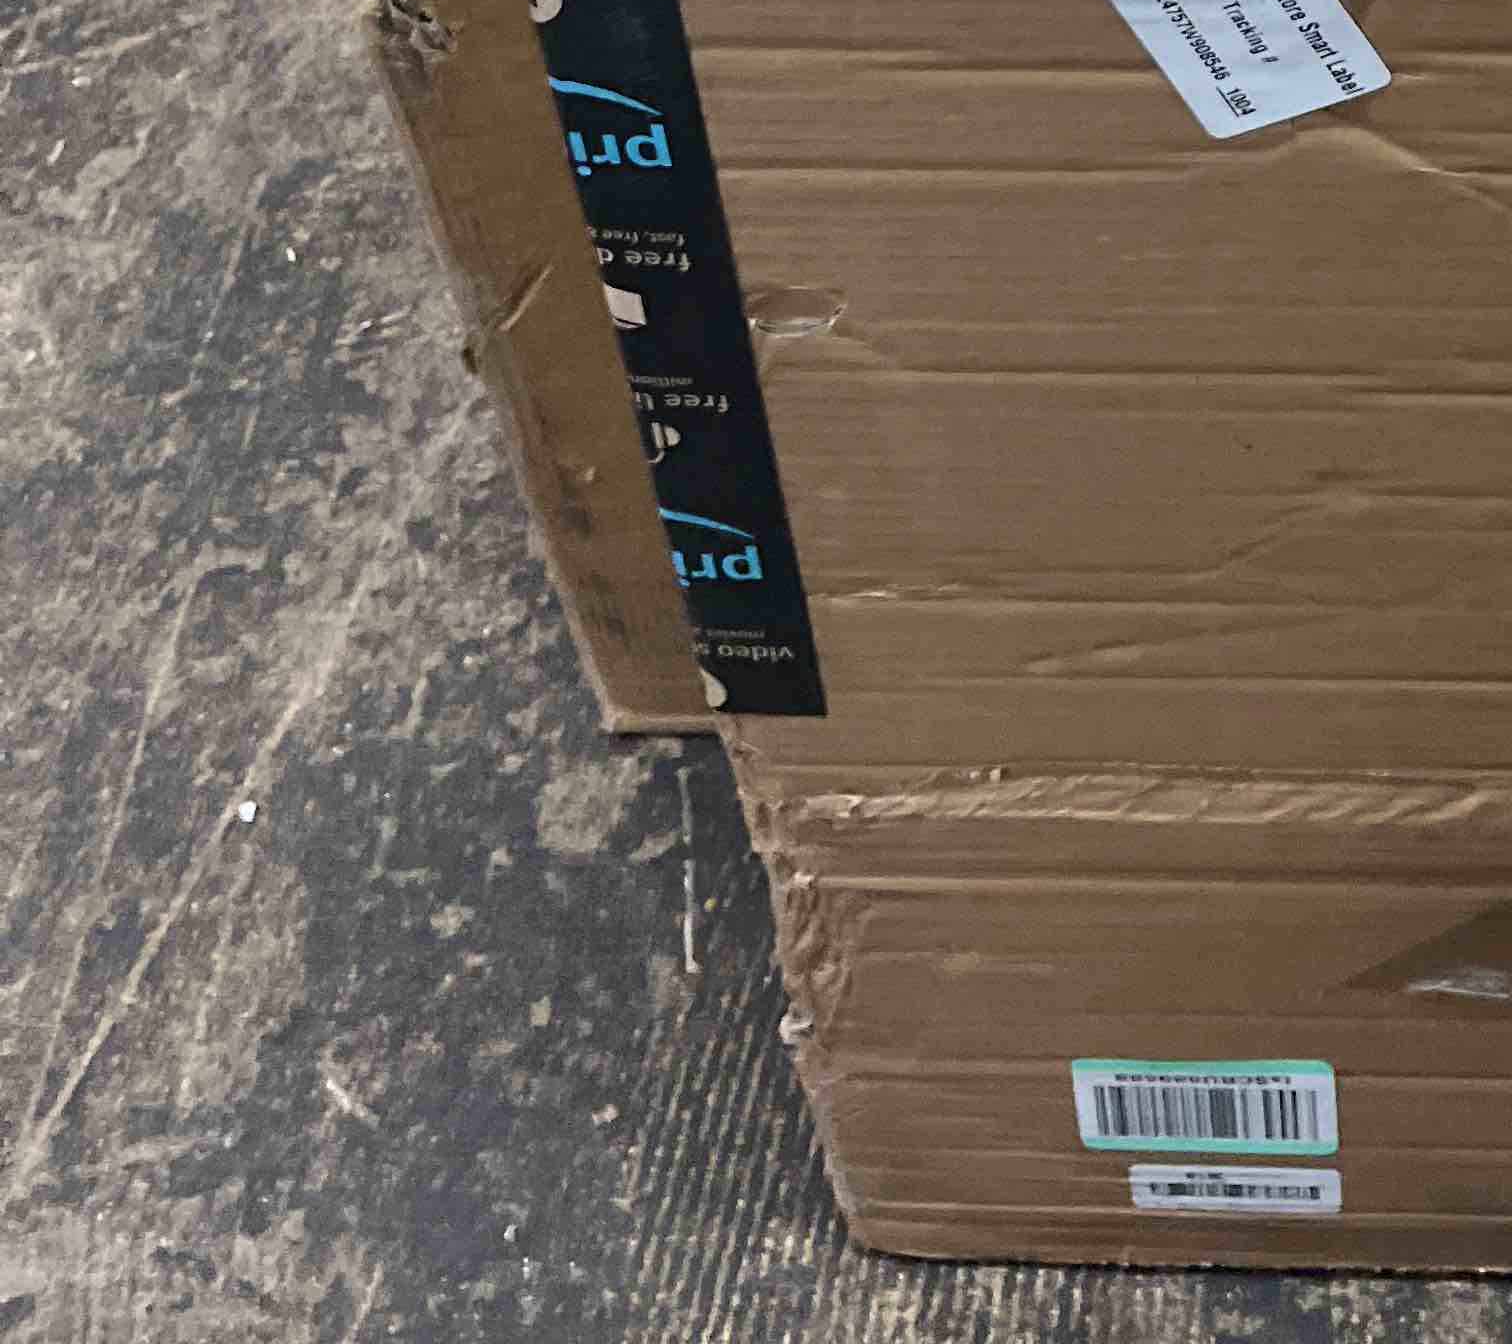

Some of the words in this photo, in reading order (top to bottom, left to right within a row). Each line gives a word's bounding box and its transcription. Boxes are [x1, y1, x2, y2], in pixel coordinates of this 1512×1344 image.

[1222, 0, 1269, 55] Tracking
[1298, 20, 1338, 60] Smart
[1326, 57, 1366, 95] Label
[625, 248, 692, 272] free
[663, 393, 729, 412] free
[717, 643, 795, 663] video
